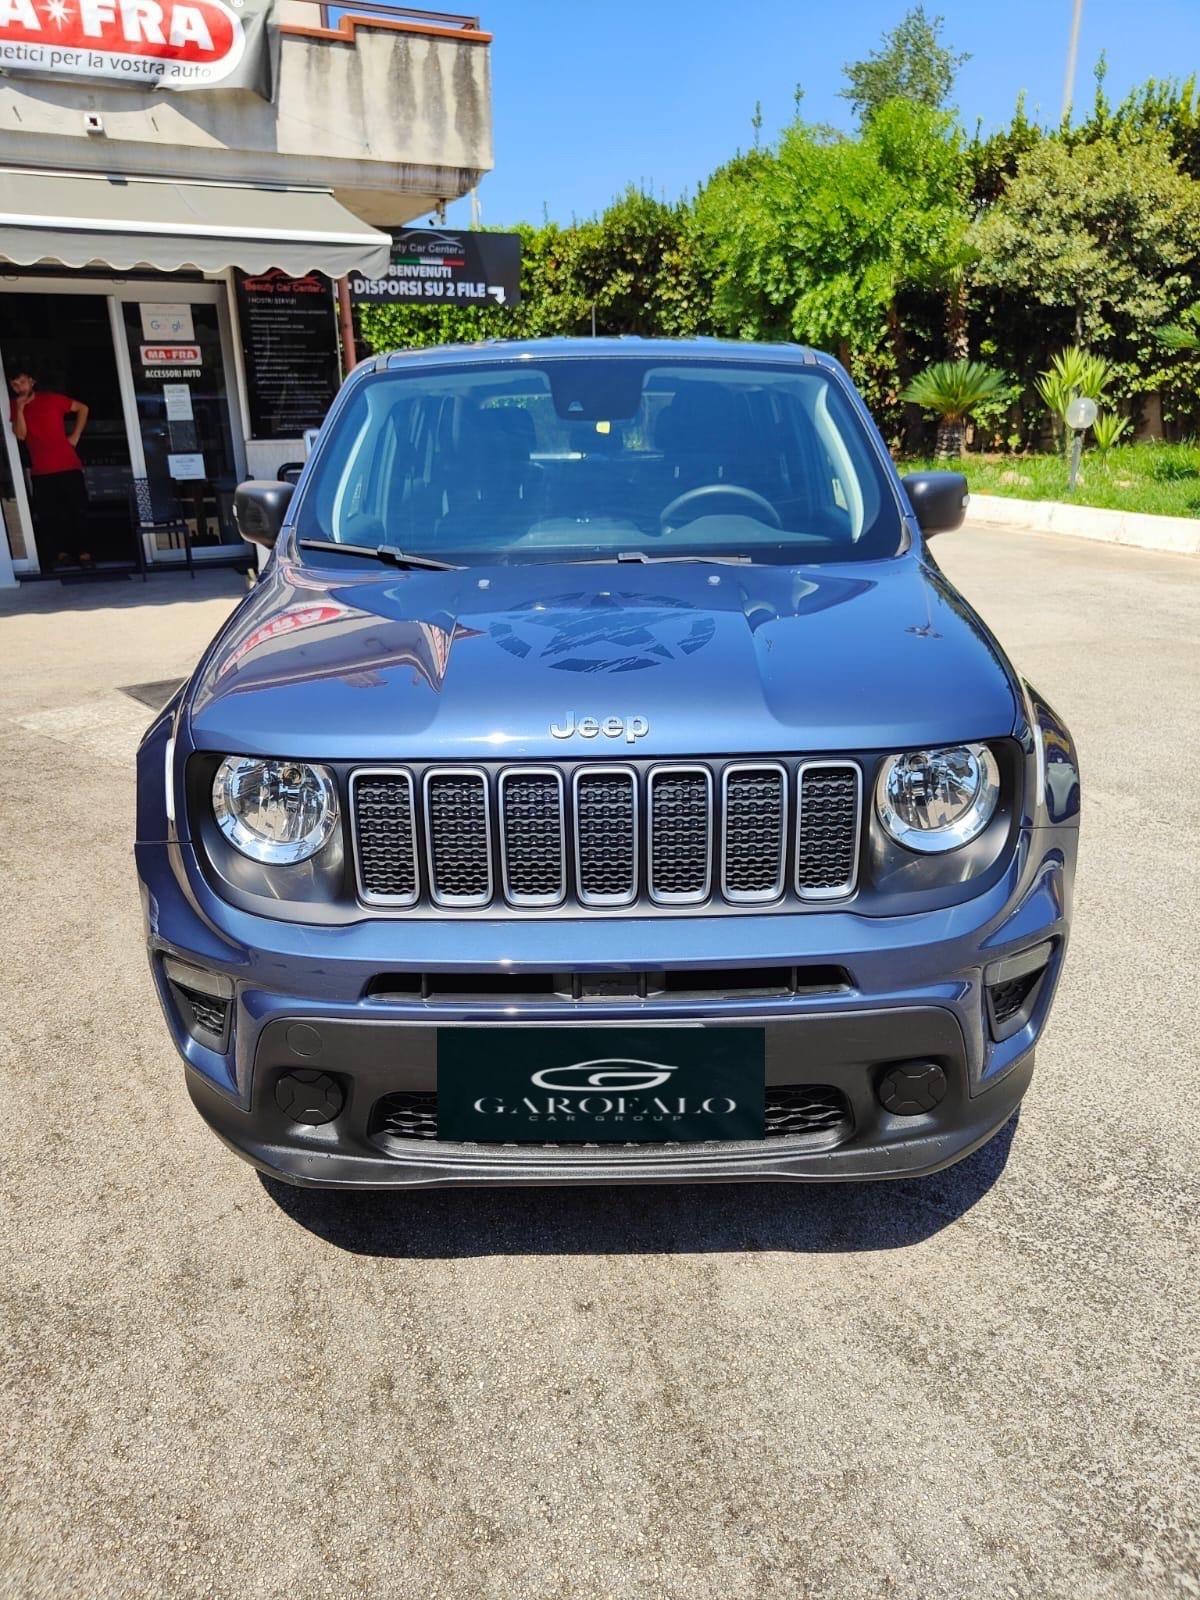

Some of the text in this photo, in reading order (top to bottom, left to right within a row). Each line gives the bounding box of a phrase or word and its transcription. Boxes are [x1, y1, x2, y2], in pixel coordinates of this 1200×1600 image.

[79, 0, 216, 51] FRA
[50, 50, 82, 68] per
[88, 52, 103, 68] la
[110, 58, 165, 75] vostra
[170, 65, 212, 78] auto
[388, 265, 452, 278] BENVENUTI
[353, 279, 486, 298] DISPORSI SU 2 FILE
[147, 350, 195, 360] MA FRA
[145, 370, 201, 378] ACCESSORI AUTO
[549, 710, 650, 744] Jeep
